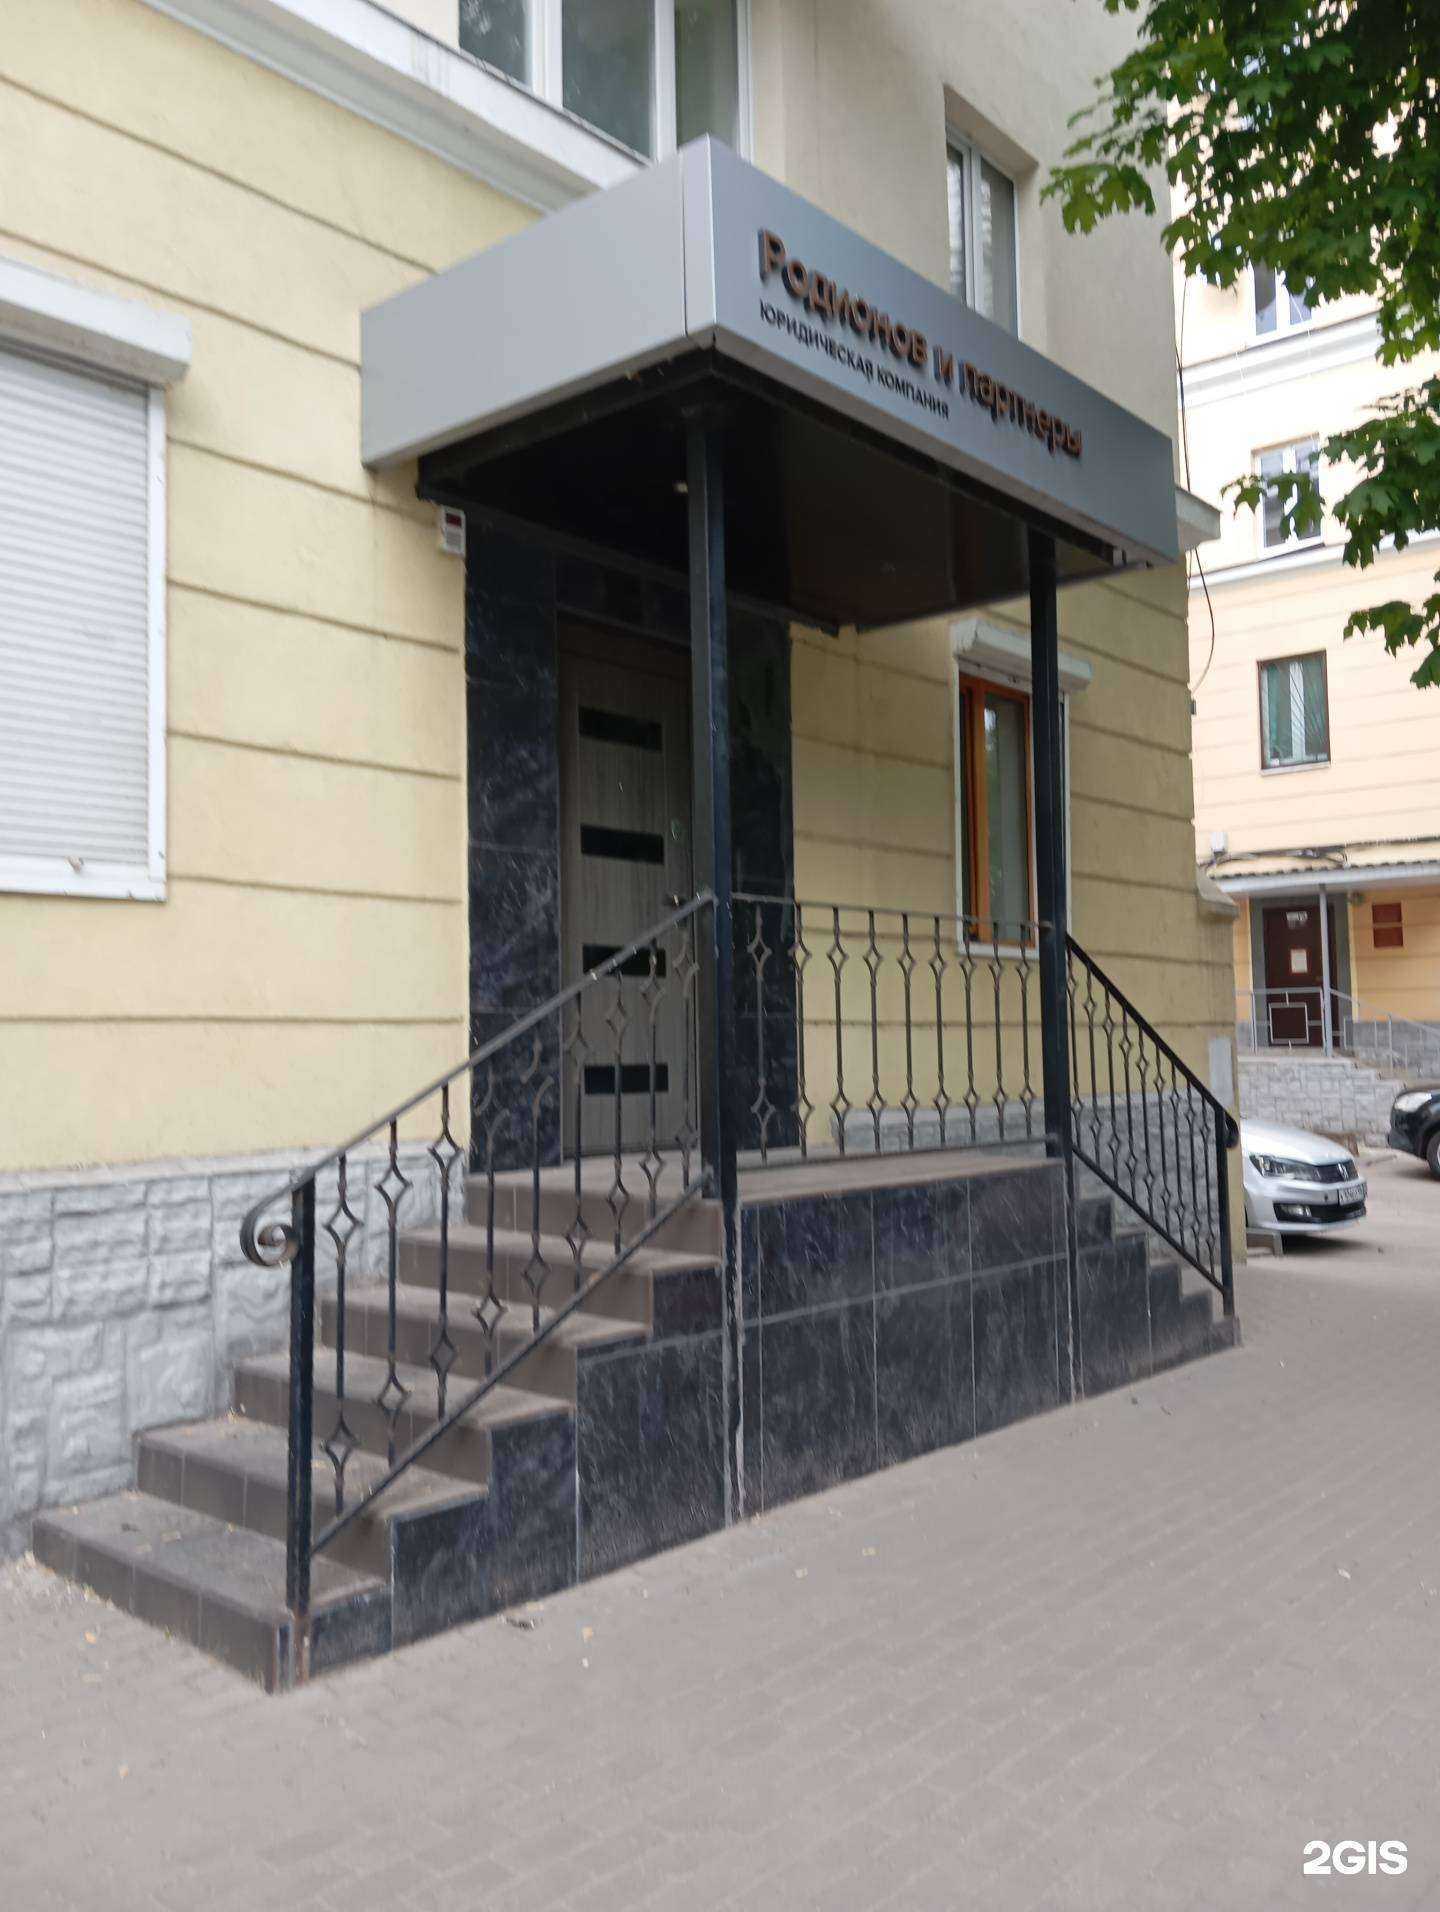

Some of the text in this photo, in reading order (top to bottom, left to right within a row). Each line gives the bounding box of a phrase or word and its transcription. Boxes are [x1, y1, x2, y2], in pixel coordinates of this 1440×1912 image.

[758, 228, 927, 369] Родионов
[759, 299, 950, 420] ЮРИДИЧЕСКАЯ КОМПАНИЯ
